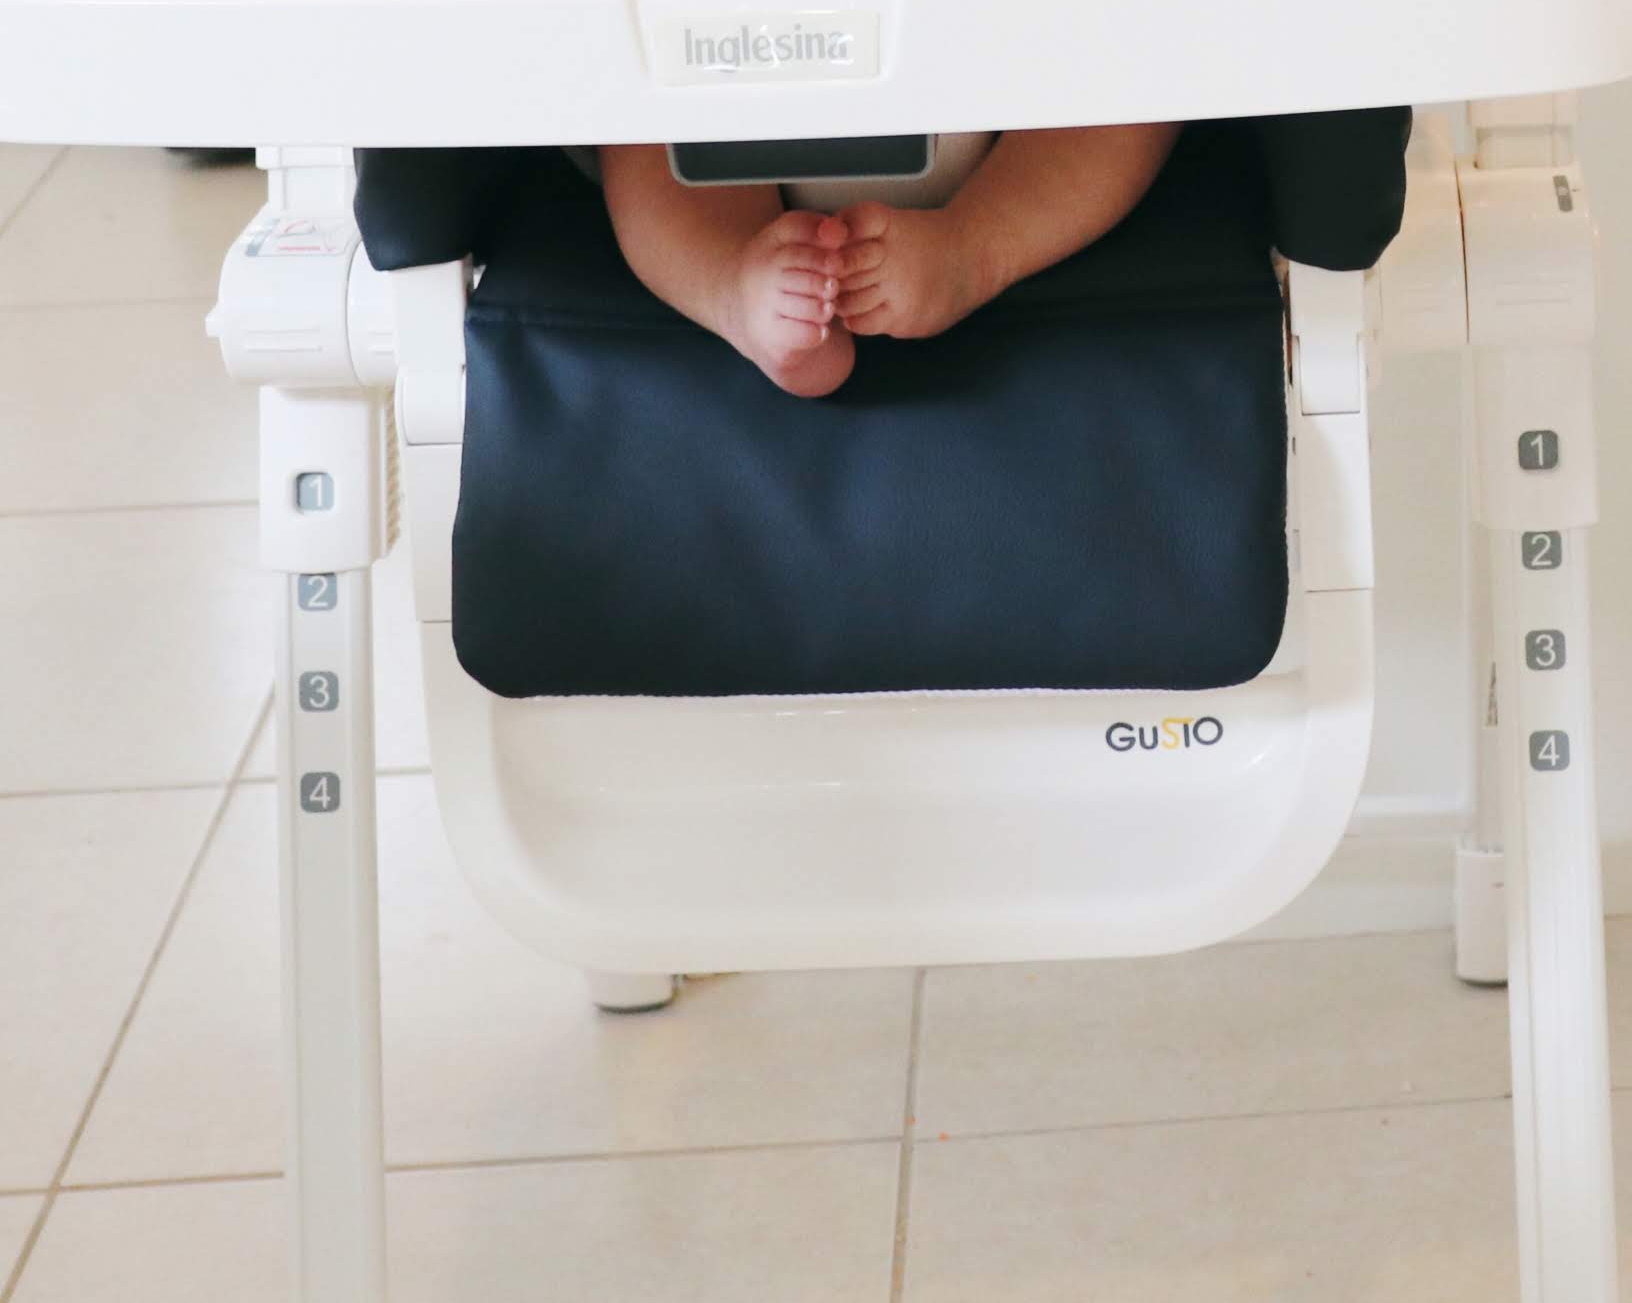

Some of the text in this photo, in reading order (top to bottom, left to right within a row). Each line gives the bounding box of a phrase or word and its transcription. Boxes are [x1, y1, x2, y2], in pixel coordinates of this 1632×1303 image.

[684, 23, 849, 73] Inglesina
[1530, 534, 1552, 566] 2
[307, 576, 329, 608] 2
[1535, 634, 1556, 667] 3
[309, 675, 330, 708] 3
[1538, 735, 1560, 767] 4
[310, 776, 331, 808] 4
